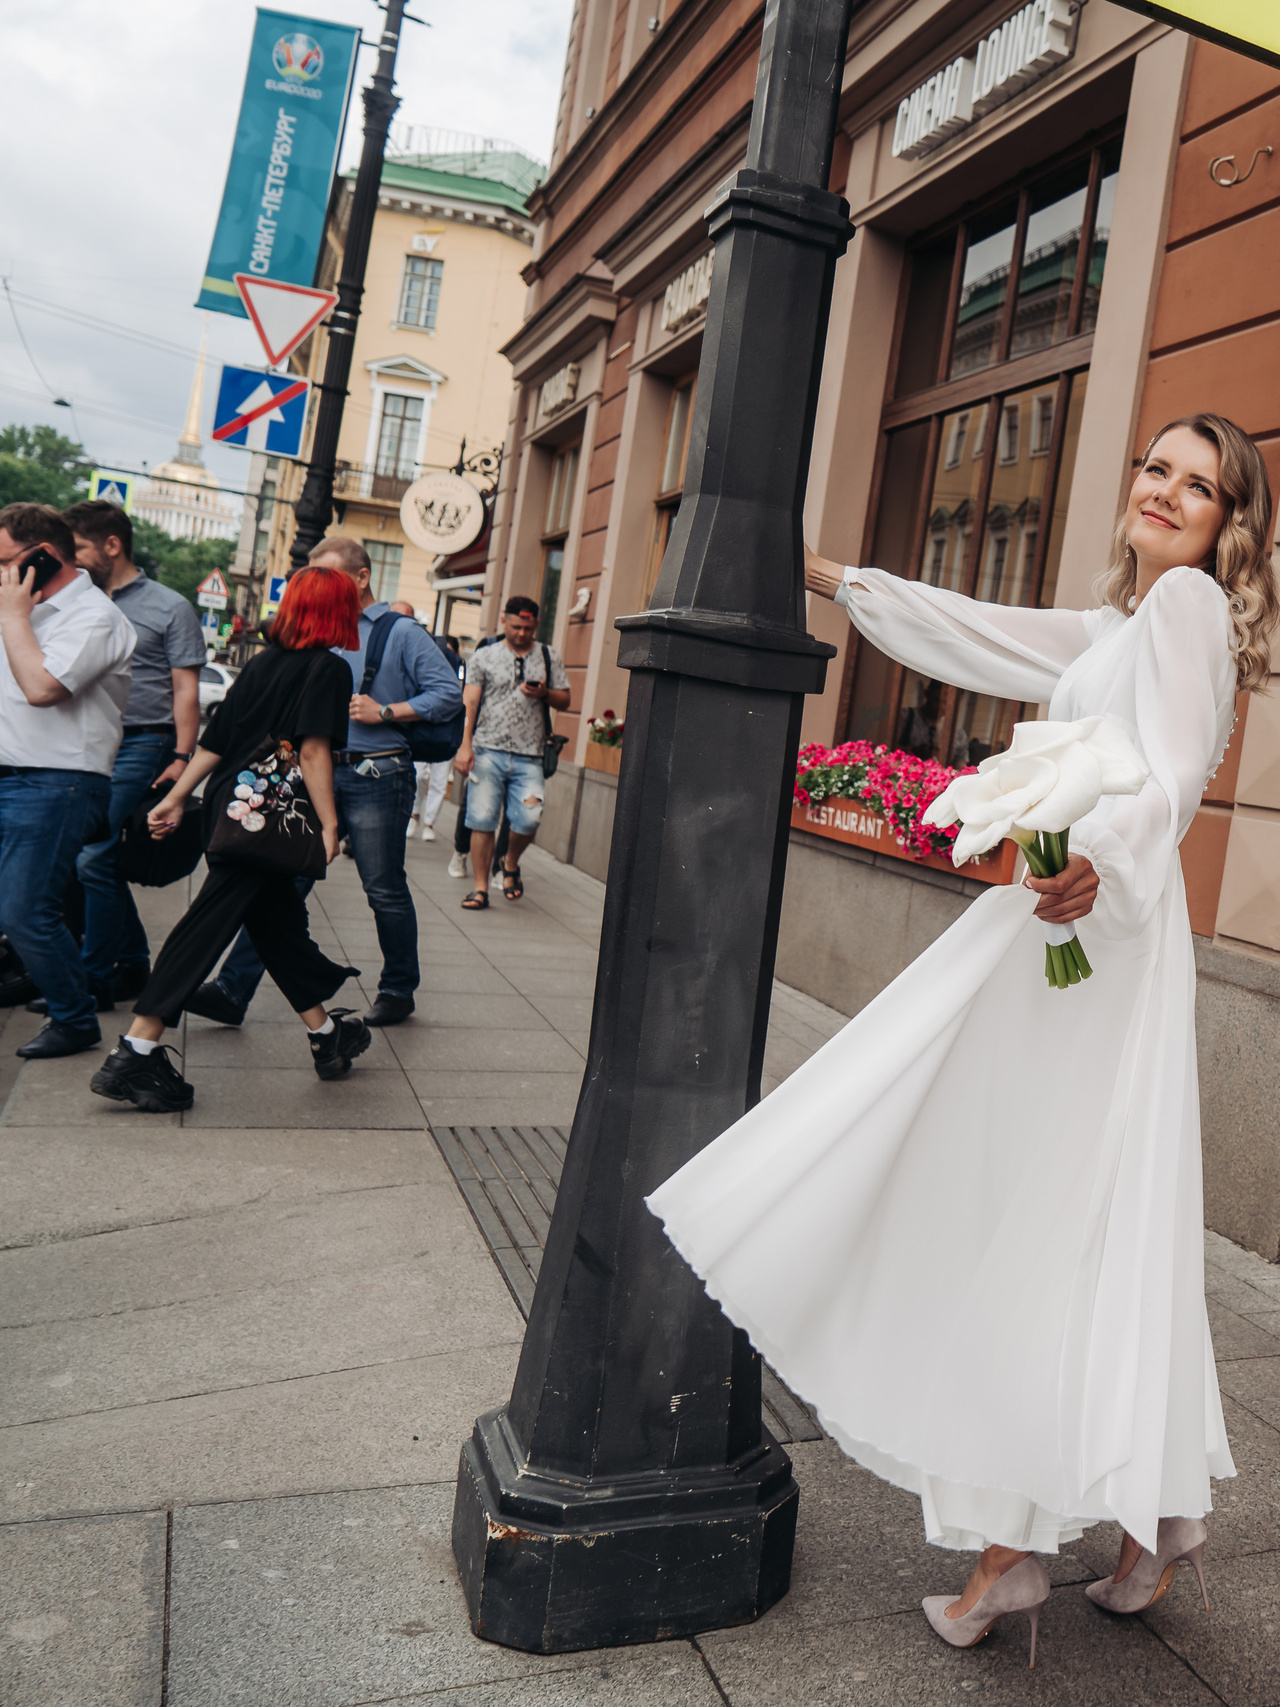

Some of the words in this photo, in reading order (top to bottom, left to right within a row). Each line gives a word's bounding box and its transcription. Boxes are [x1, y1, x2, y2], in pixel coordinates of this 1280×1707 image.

[892, 56, 970, 159] CINEMA
[971, 0, 1066, 105] LOUNGE
[249, 107, 297, 275] САНКТ-ПЕТЕРБУРГ
